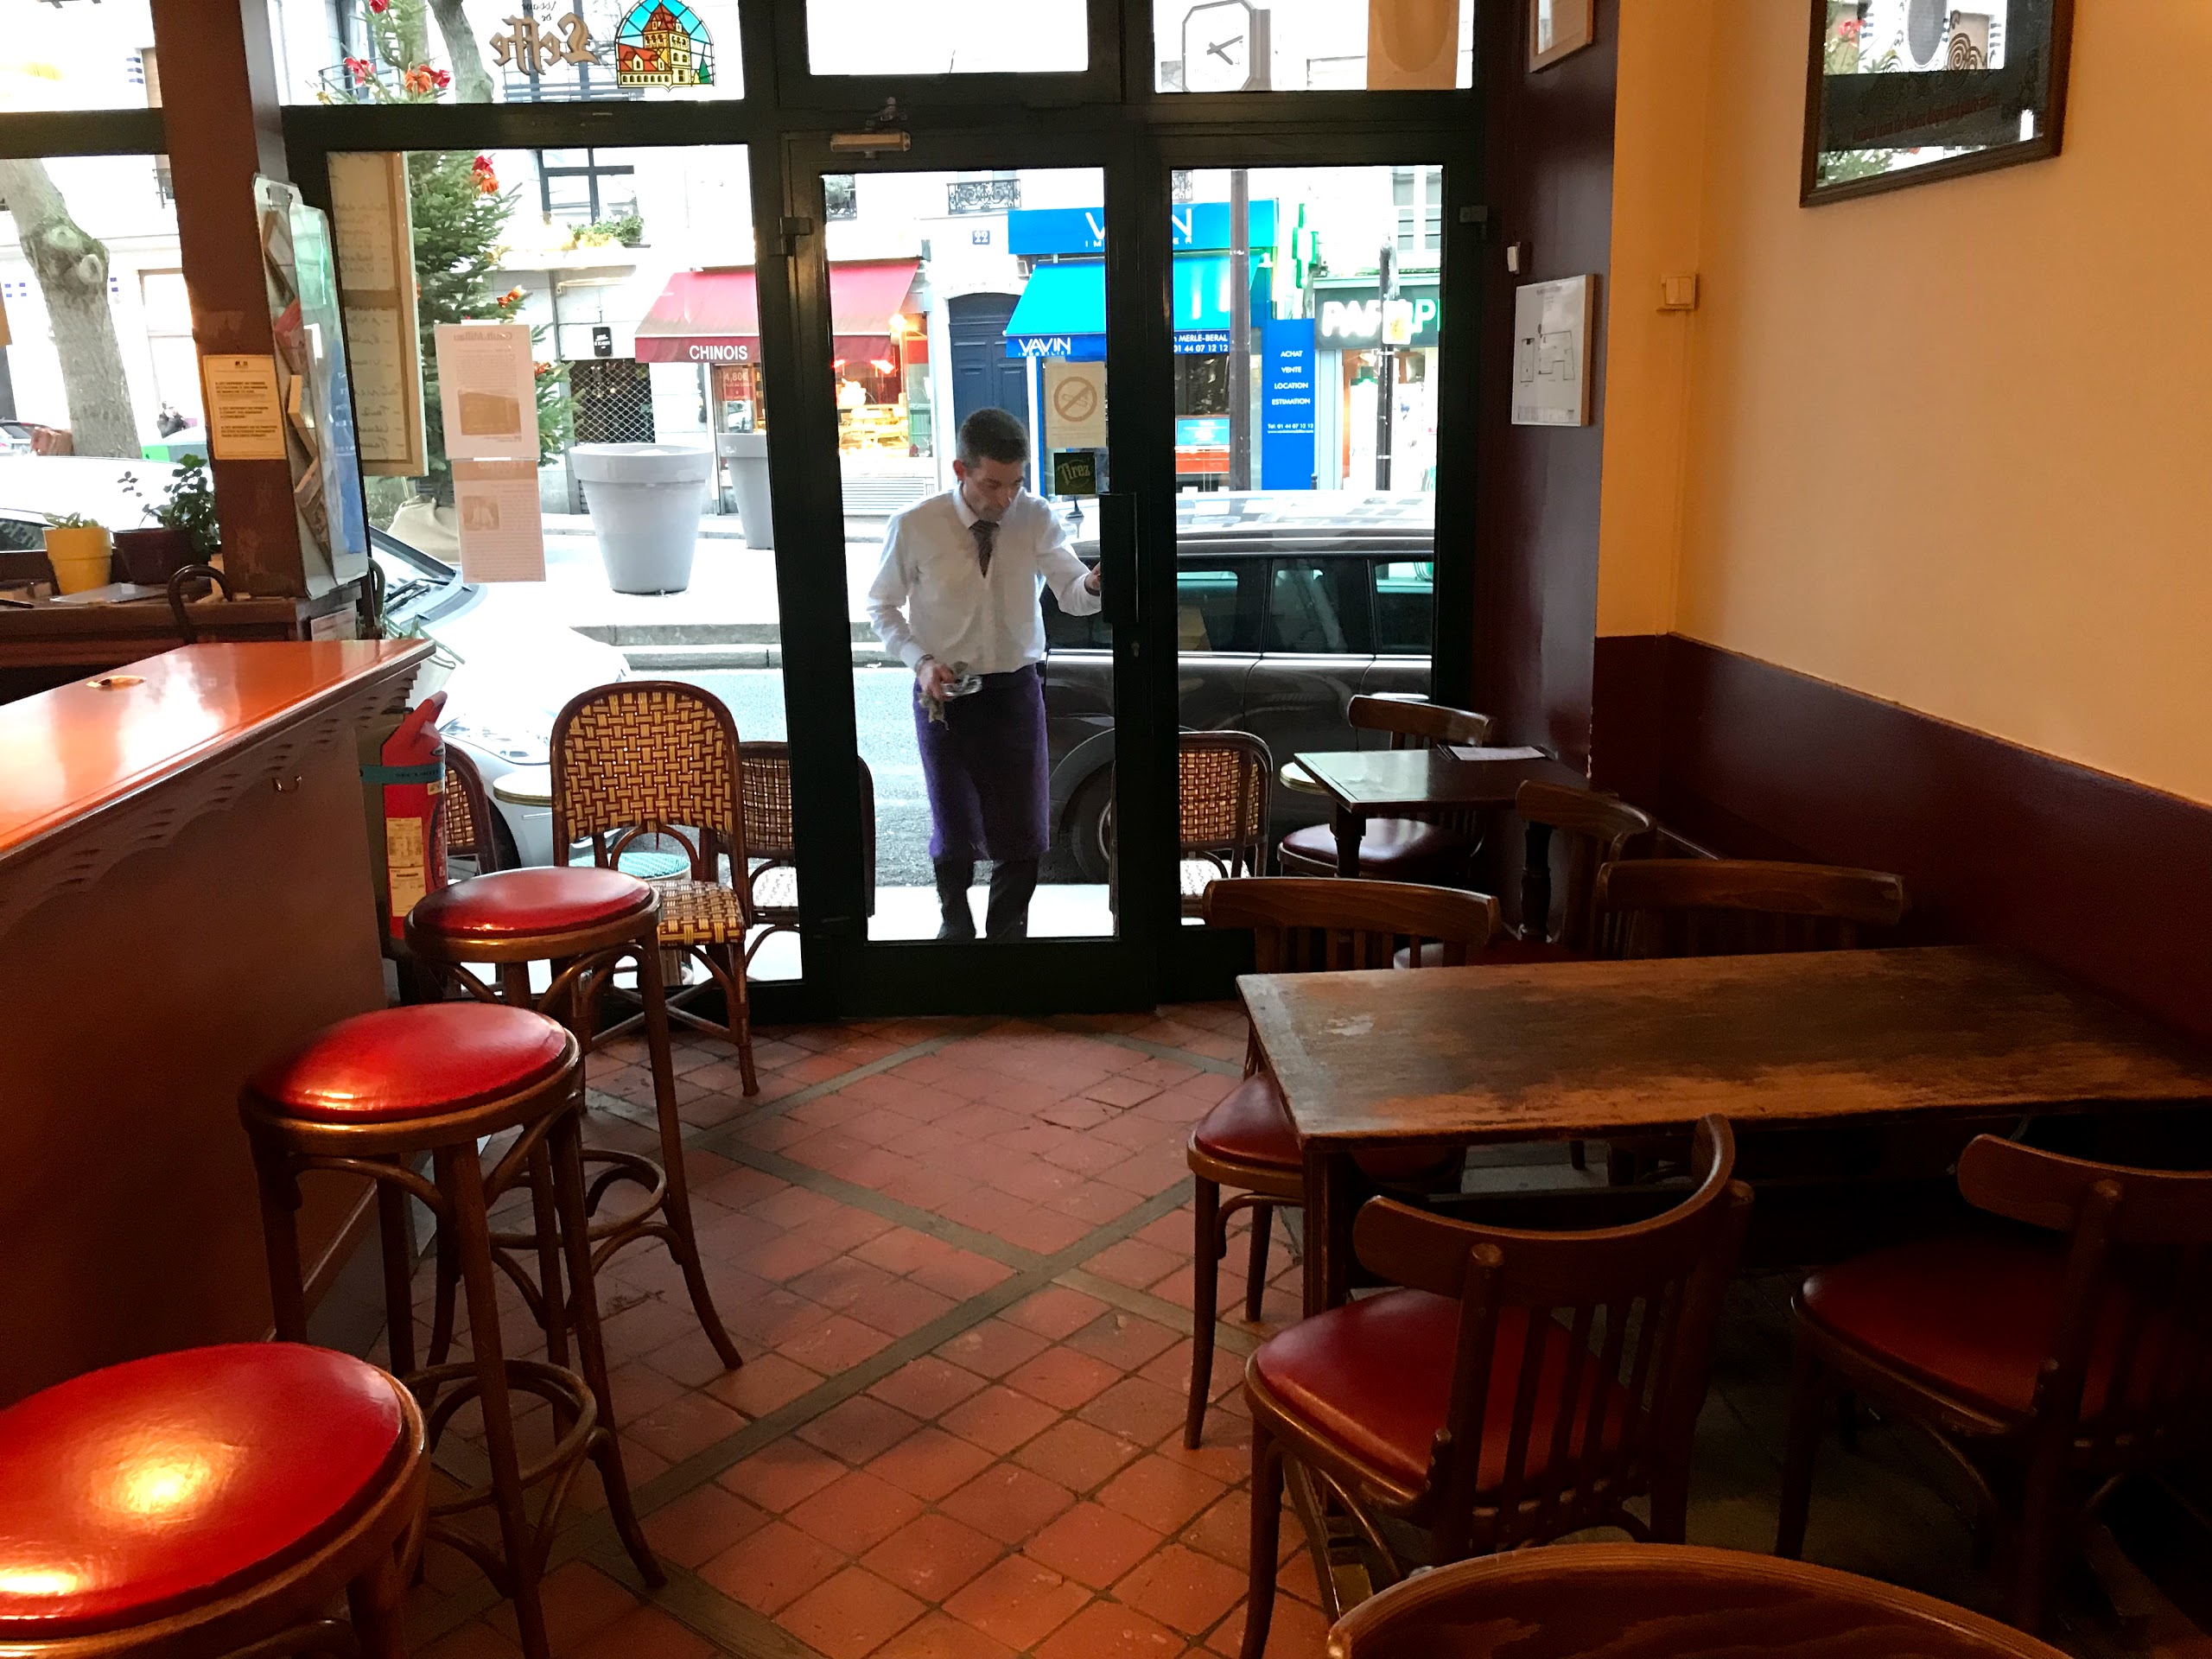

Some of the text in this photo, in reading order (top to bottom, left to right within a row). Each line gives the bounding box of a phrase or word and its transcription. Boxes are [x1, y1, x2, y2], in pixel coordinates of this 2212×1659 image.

[974, 231, 988, 243] 22
[1179, 334, 1228, 342] MERLE-BERAL
[1018, 337, 1071, 353] VAVIN
[1219, 344, 1228, 353] 12
[689, 345, 748, 360] CHINOIS
[1058, 461, 1090, 486] Tirez
